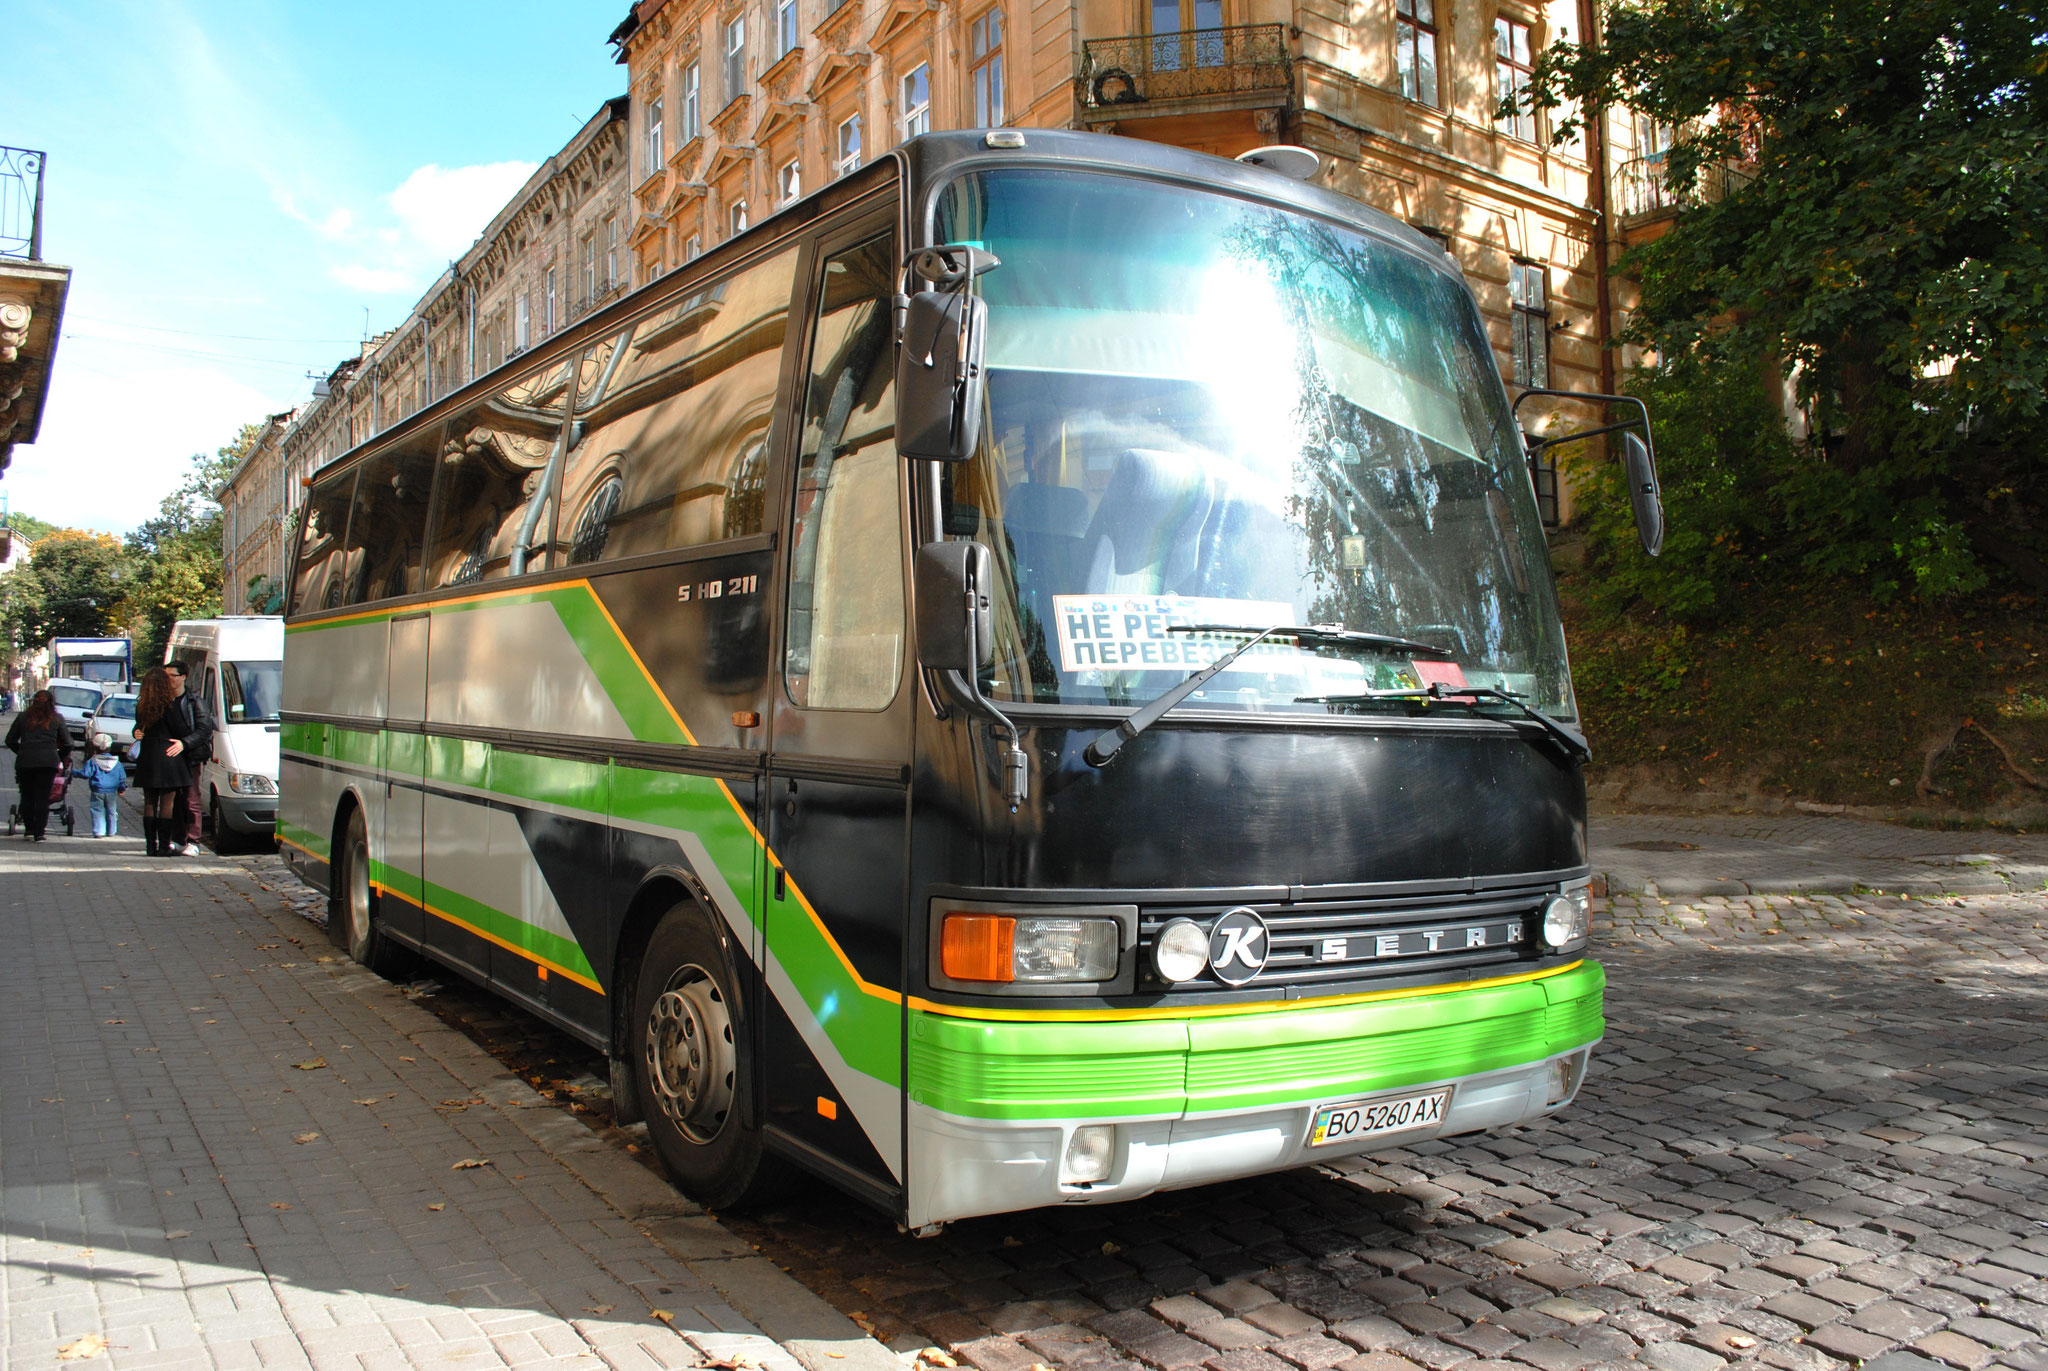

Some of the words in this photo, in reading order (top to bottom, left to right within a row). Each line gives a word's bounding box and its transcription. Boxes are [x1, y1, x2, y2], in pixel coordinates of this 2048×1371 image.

[678, 585, 691, 602] S
[728, 575, 758, 596] 211
[1067, 614, 1114, 639] НЕ
[1213, 926, 1265, 968] K
[1321, 922, 1525, 962] SETRA
[1327, 1110, 1360, 1137] BO
[1363, 1101, 1411, 1131] 5260
[1412, 1095, 1443, 1123] AX
